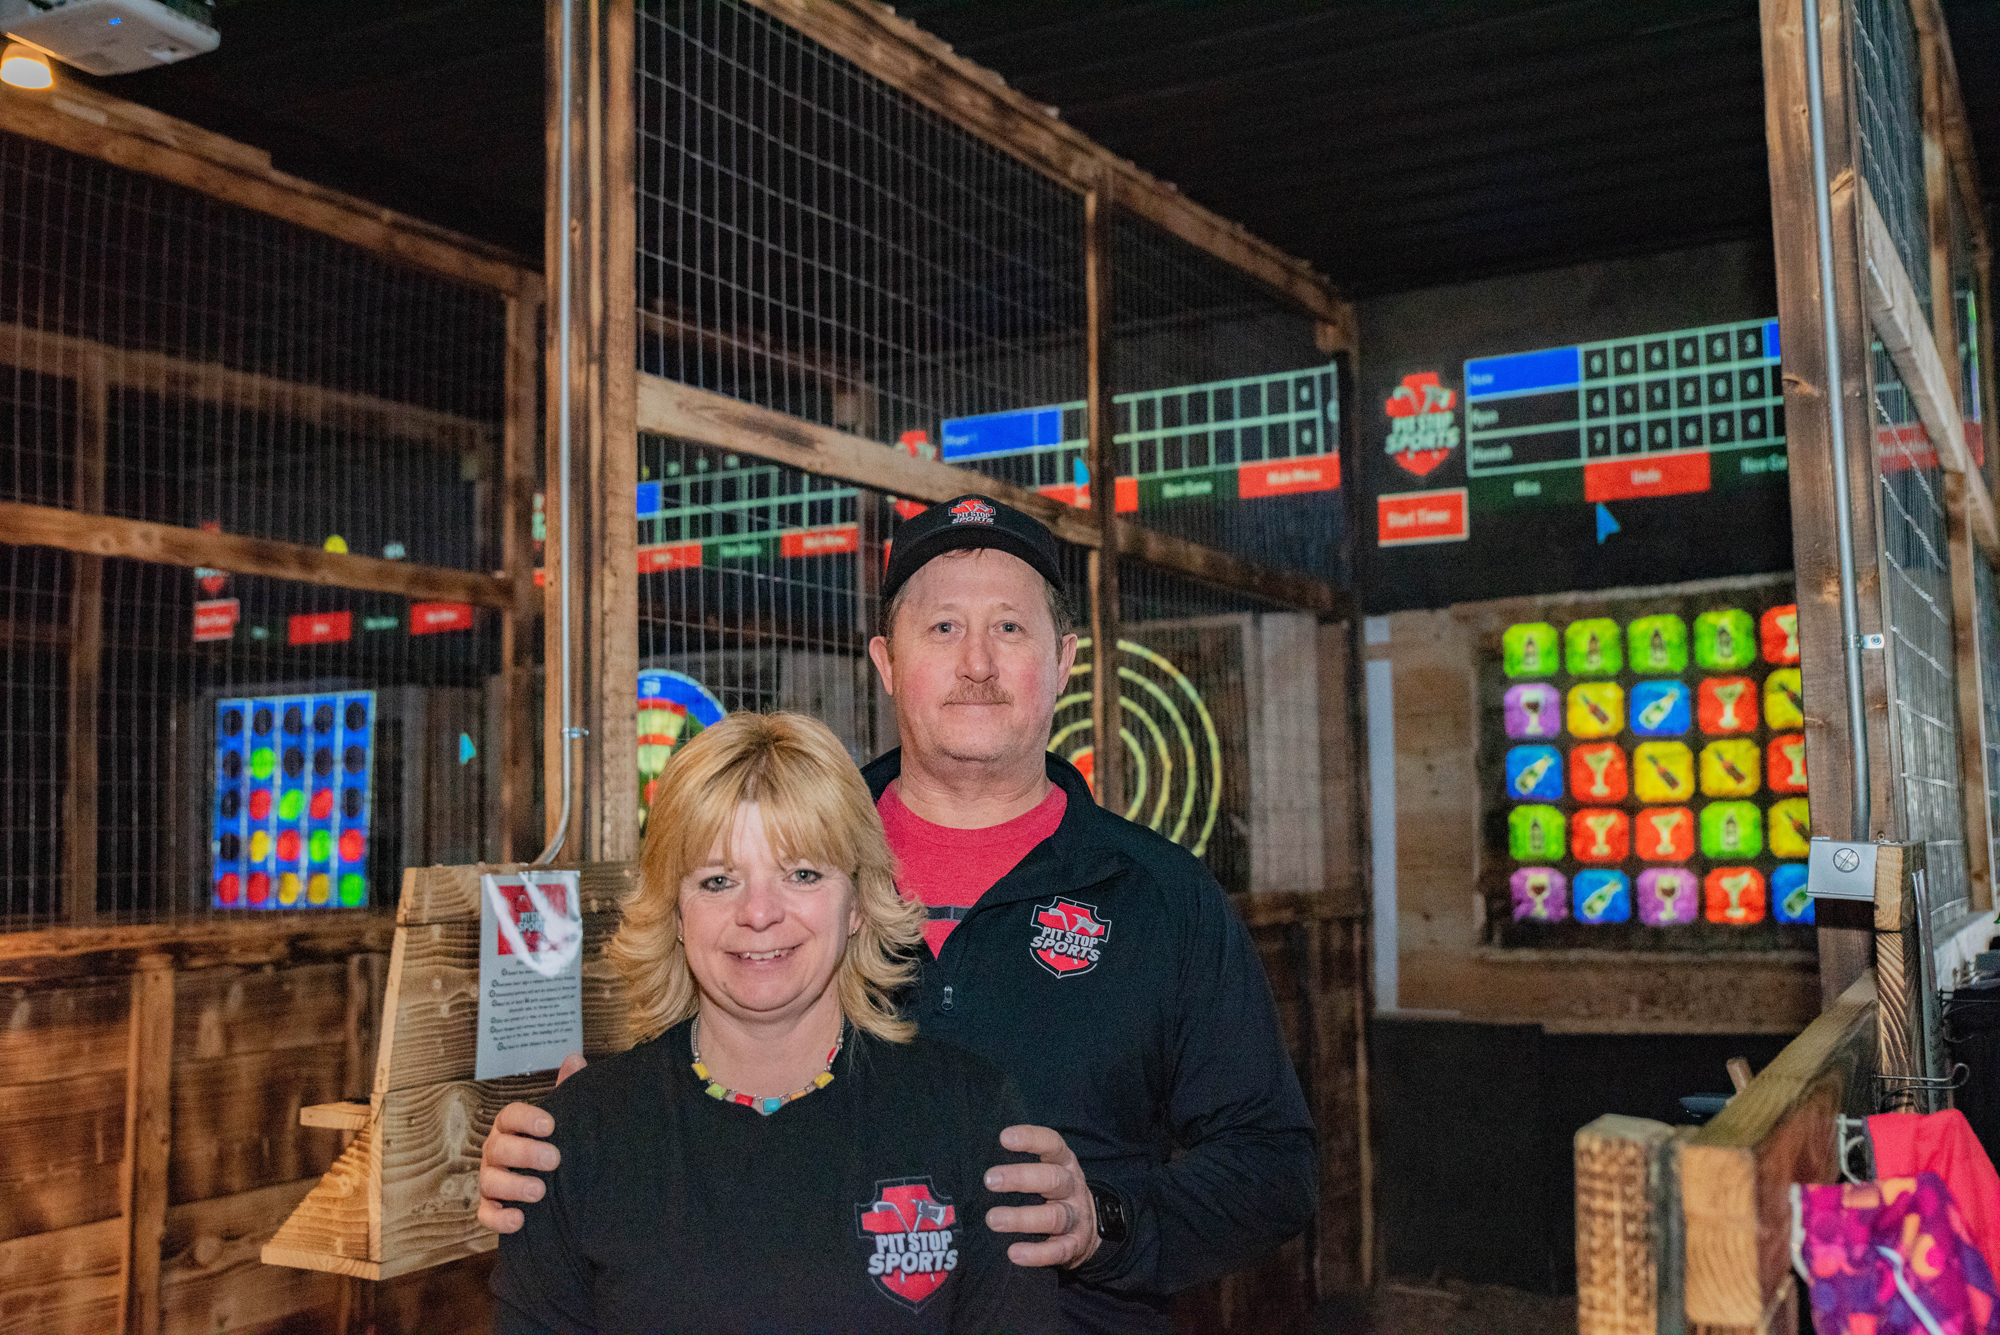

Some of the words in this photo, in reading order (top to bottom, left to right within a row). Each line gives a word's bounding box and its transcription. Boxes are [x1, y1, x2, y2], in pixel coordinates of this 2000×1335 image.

[952, 516, 994, 524] SPORTS
[1030, 936, 1101, 961] SPORTS
[1041, 926, 1064, 940] PIT
[1064, 931, 1098, 948] STOP
[875, 1233, 906, 1254] PIT
[907, 1230, 952, 1253] STOP
[868, 1249, 958, 1275] SPORTS
